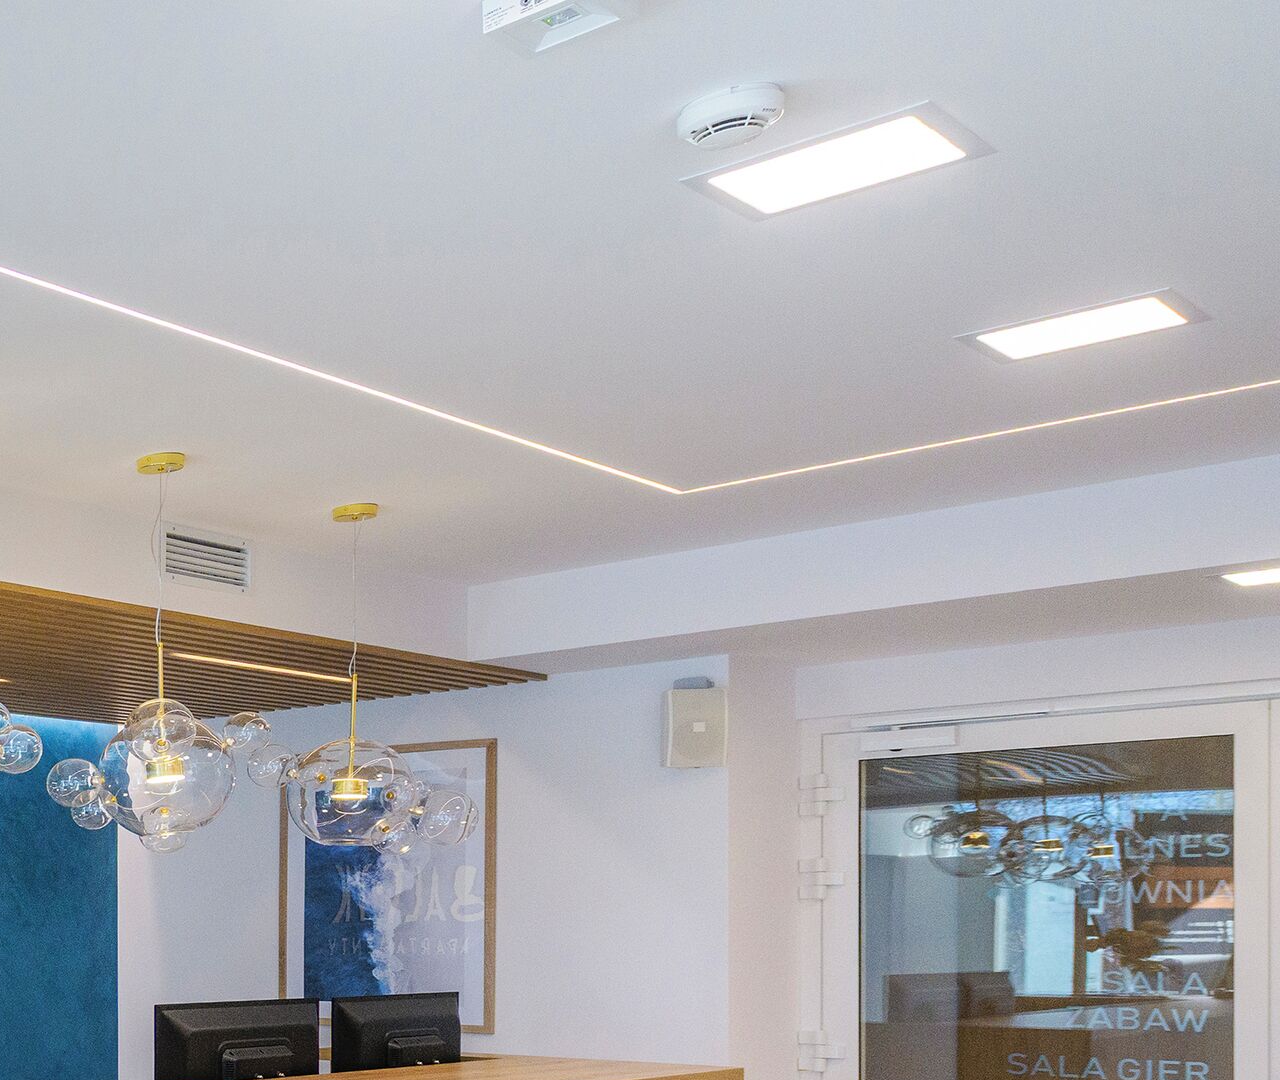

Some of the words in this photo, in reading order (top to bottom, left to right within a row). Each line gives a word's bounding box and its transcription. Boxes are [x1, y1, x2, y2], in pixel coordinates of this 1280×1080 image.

[1104, 971, 1209, 995] SALA
[1066, 1006, 1209, 1033] ZABAW
[1007, 1053, 1107, 1080] SALA
